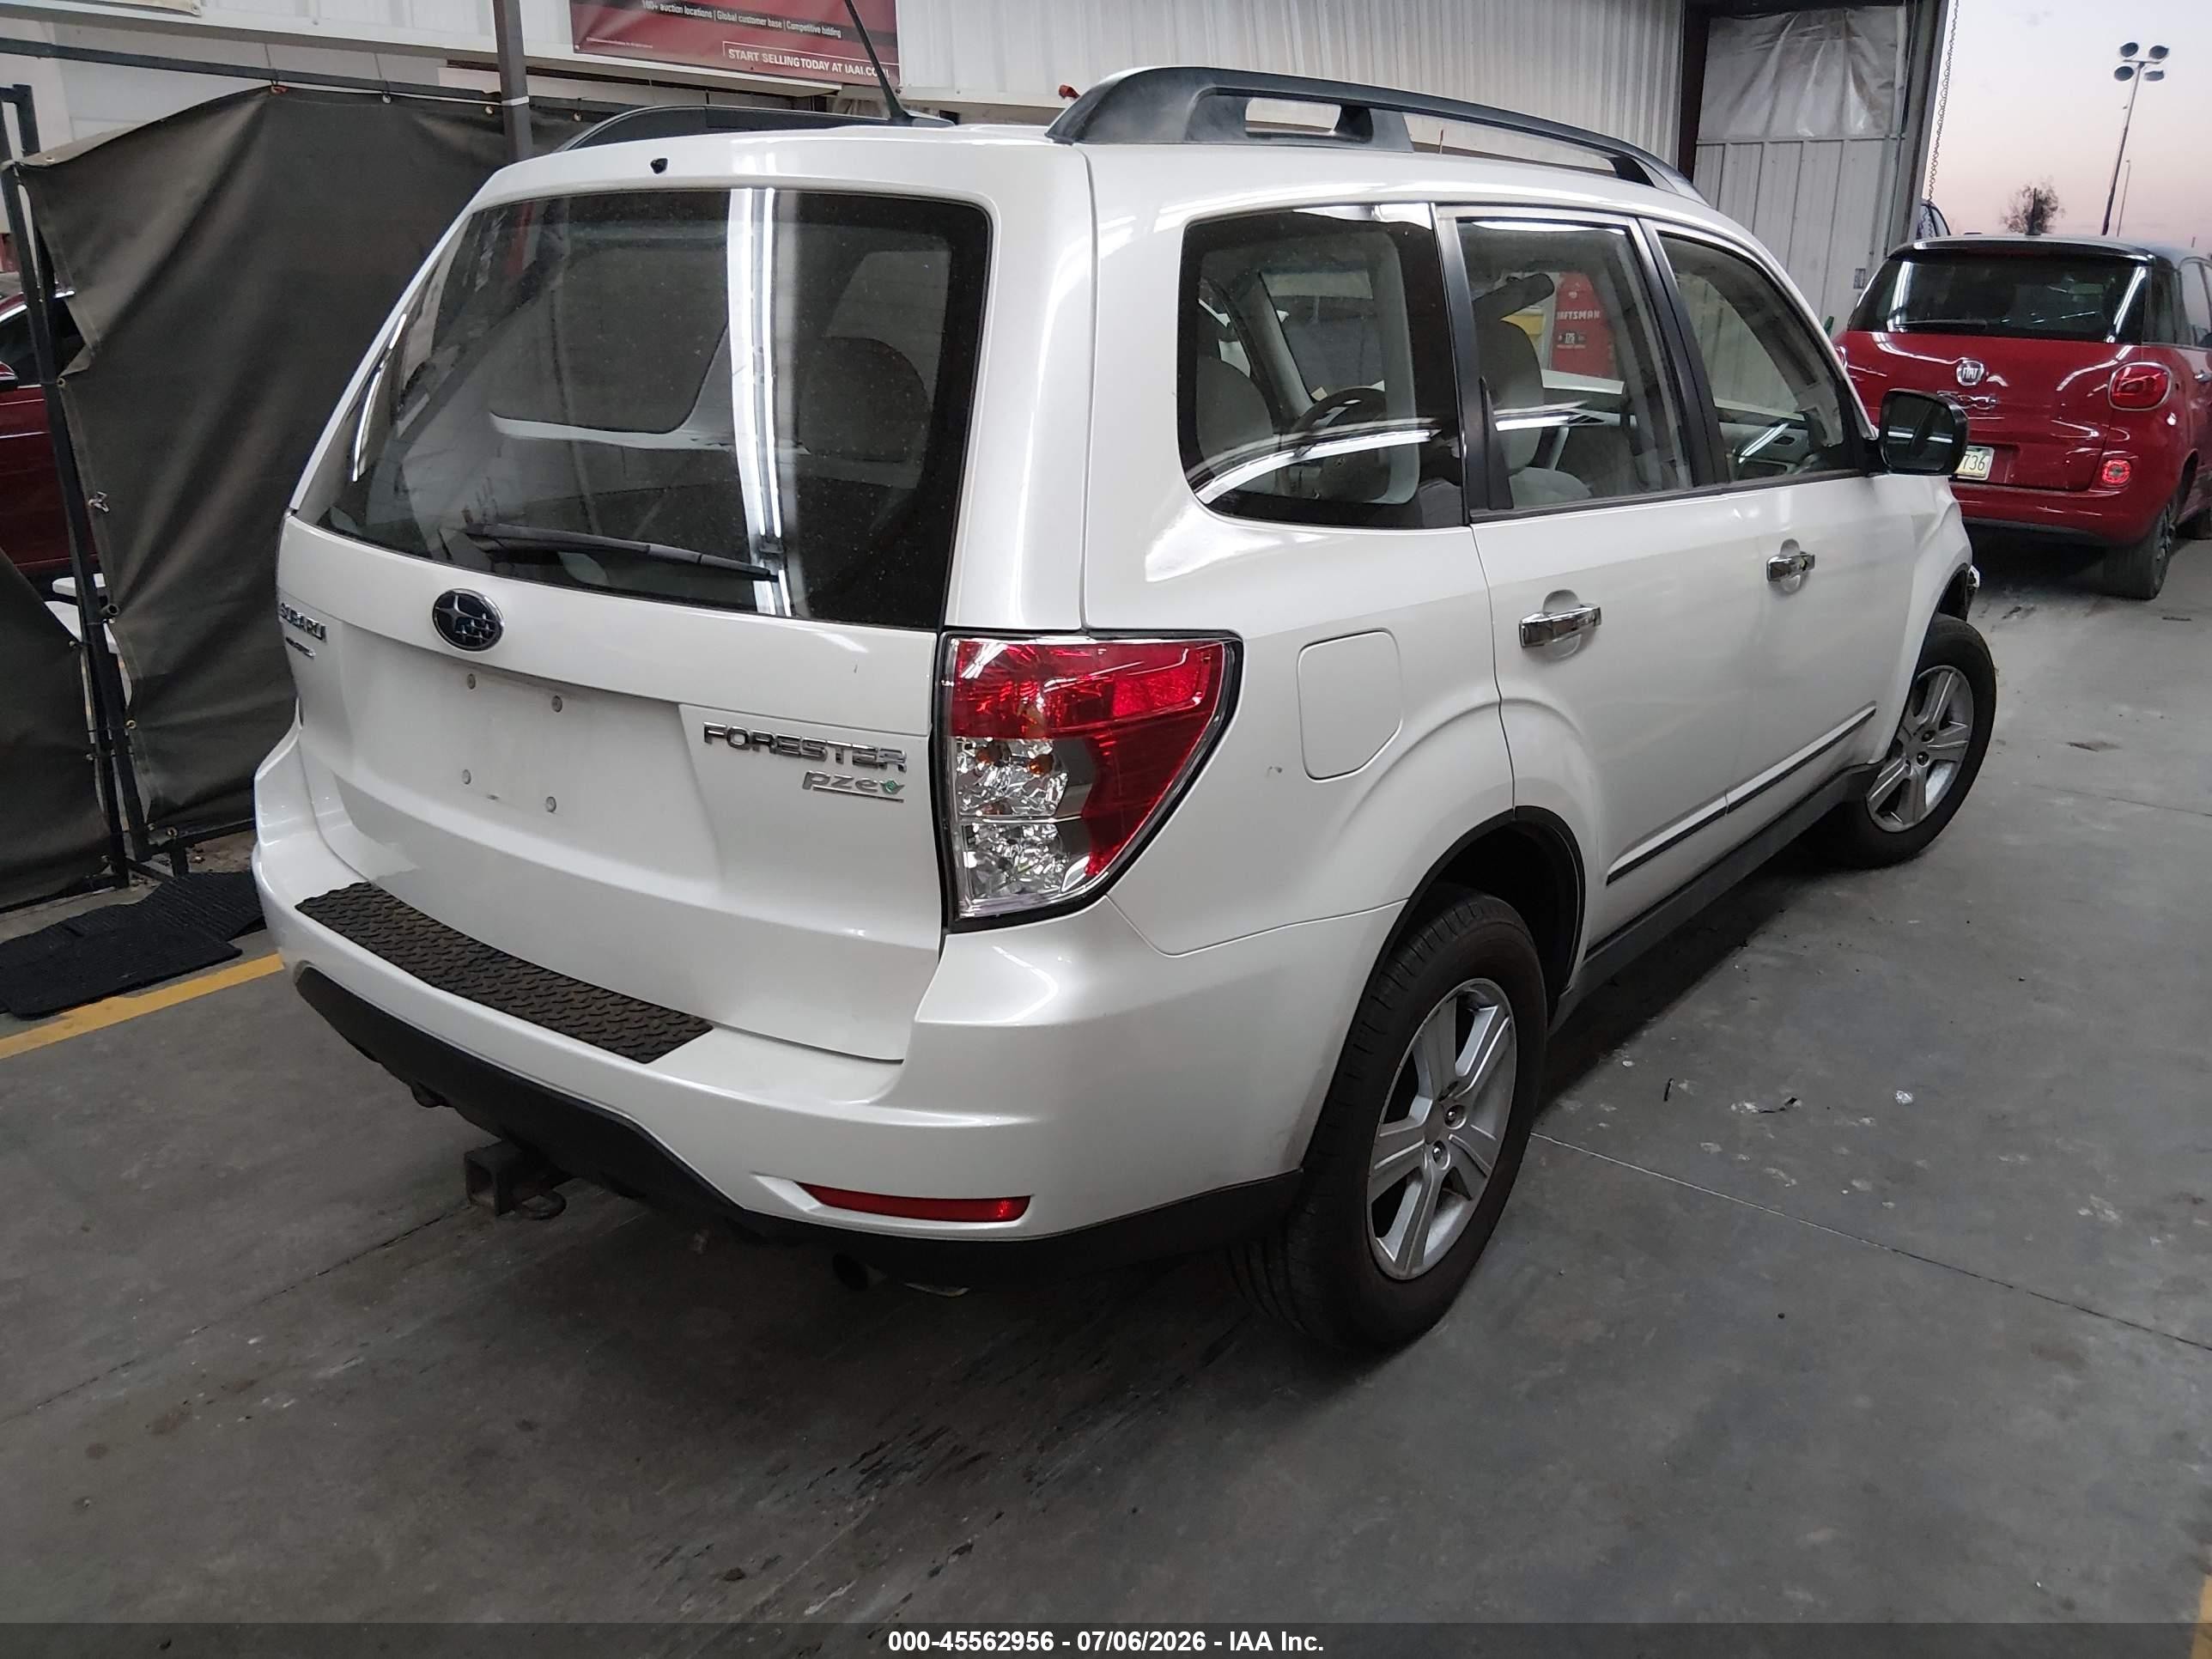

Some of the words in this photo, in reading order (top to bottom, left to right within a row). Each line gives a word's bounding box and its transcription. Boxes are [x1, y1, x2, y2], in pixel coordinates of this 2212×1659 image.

[659, 3, 684, 14] auction
[684, 5, 713, 19] locations
[717, 10, 738, 22] Global
[738, 15, 767, 27] customer
[768, 17, 782, 28] base
[787, 21, 821, 35] Competitive
[822, 26, 842, 39] bidding
[728, 49, 759, 63] START
[762, 53, 799, 68] SELLING
[800, 58, 830, 72] TODAY
[831, 64, 843, 73] AT
[1962, 366, 1978, 380] FIAT
[280, 602, 327, 643] SUBARU
[703, 721, 908, 774] FORESTER
